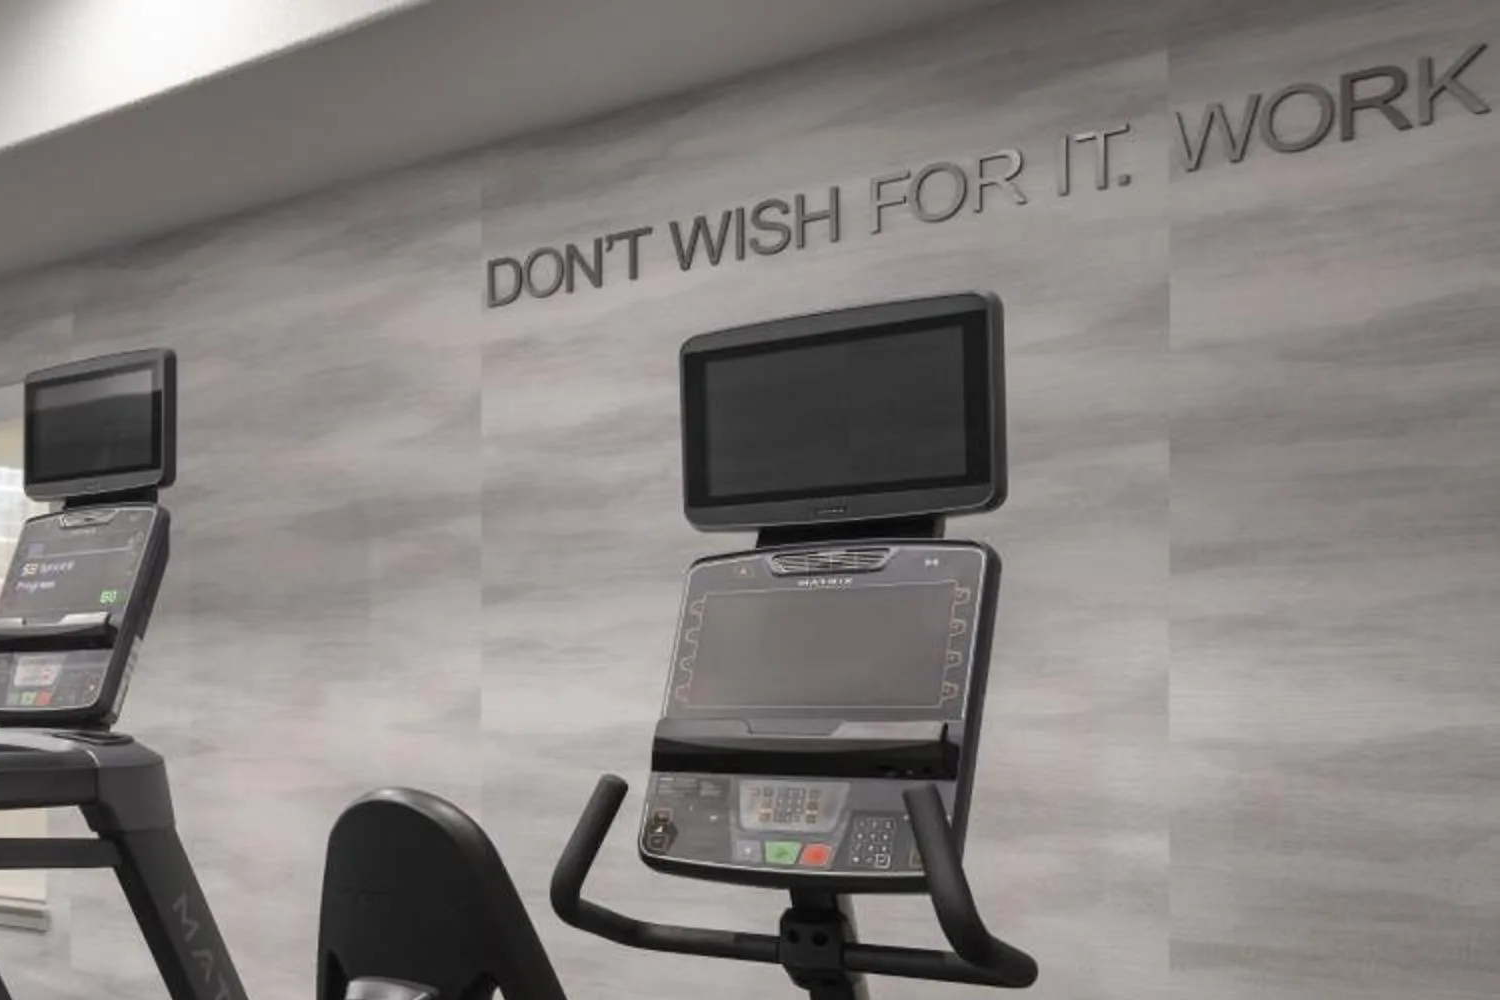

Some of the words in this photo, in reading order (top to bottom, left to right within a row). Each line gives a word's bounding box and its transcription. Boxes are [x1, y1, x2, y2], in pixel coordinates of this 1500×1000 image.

[486, 226, 654, 309] DON'T
[668, 185, 840, 273] WISH
[869, 148, 1029, 236] FOR
[1056, 121, 1132, 197] IT.
[1172, 42, 1493, 173] WORK
